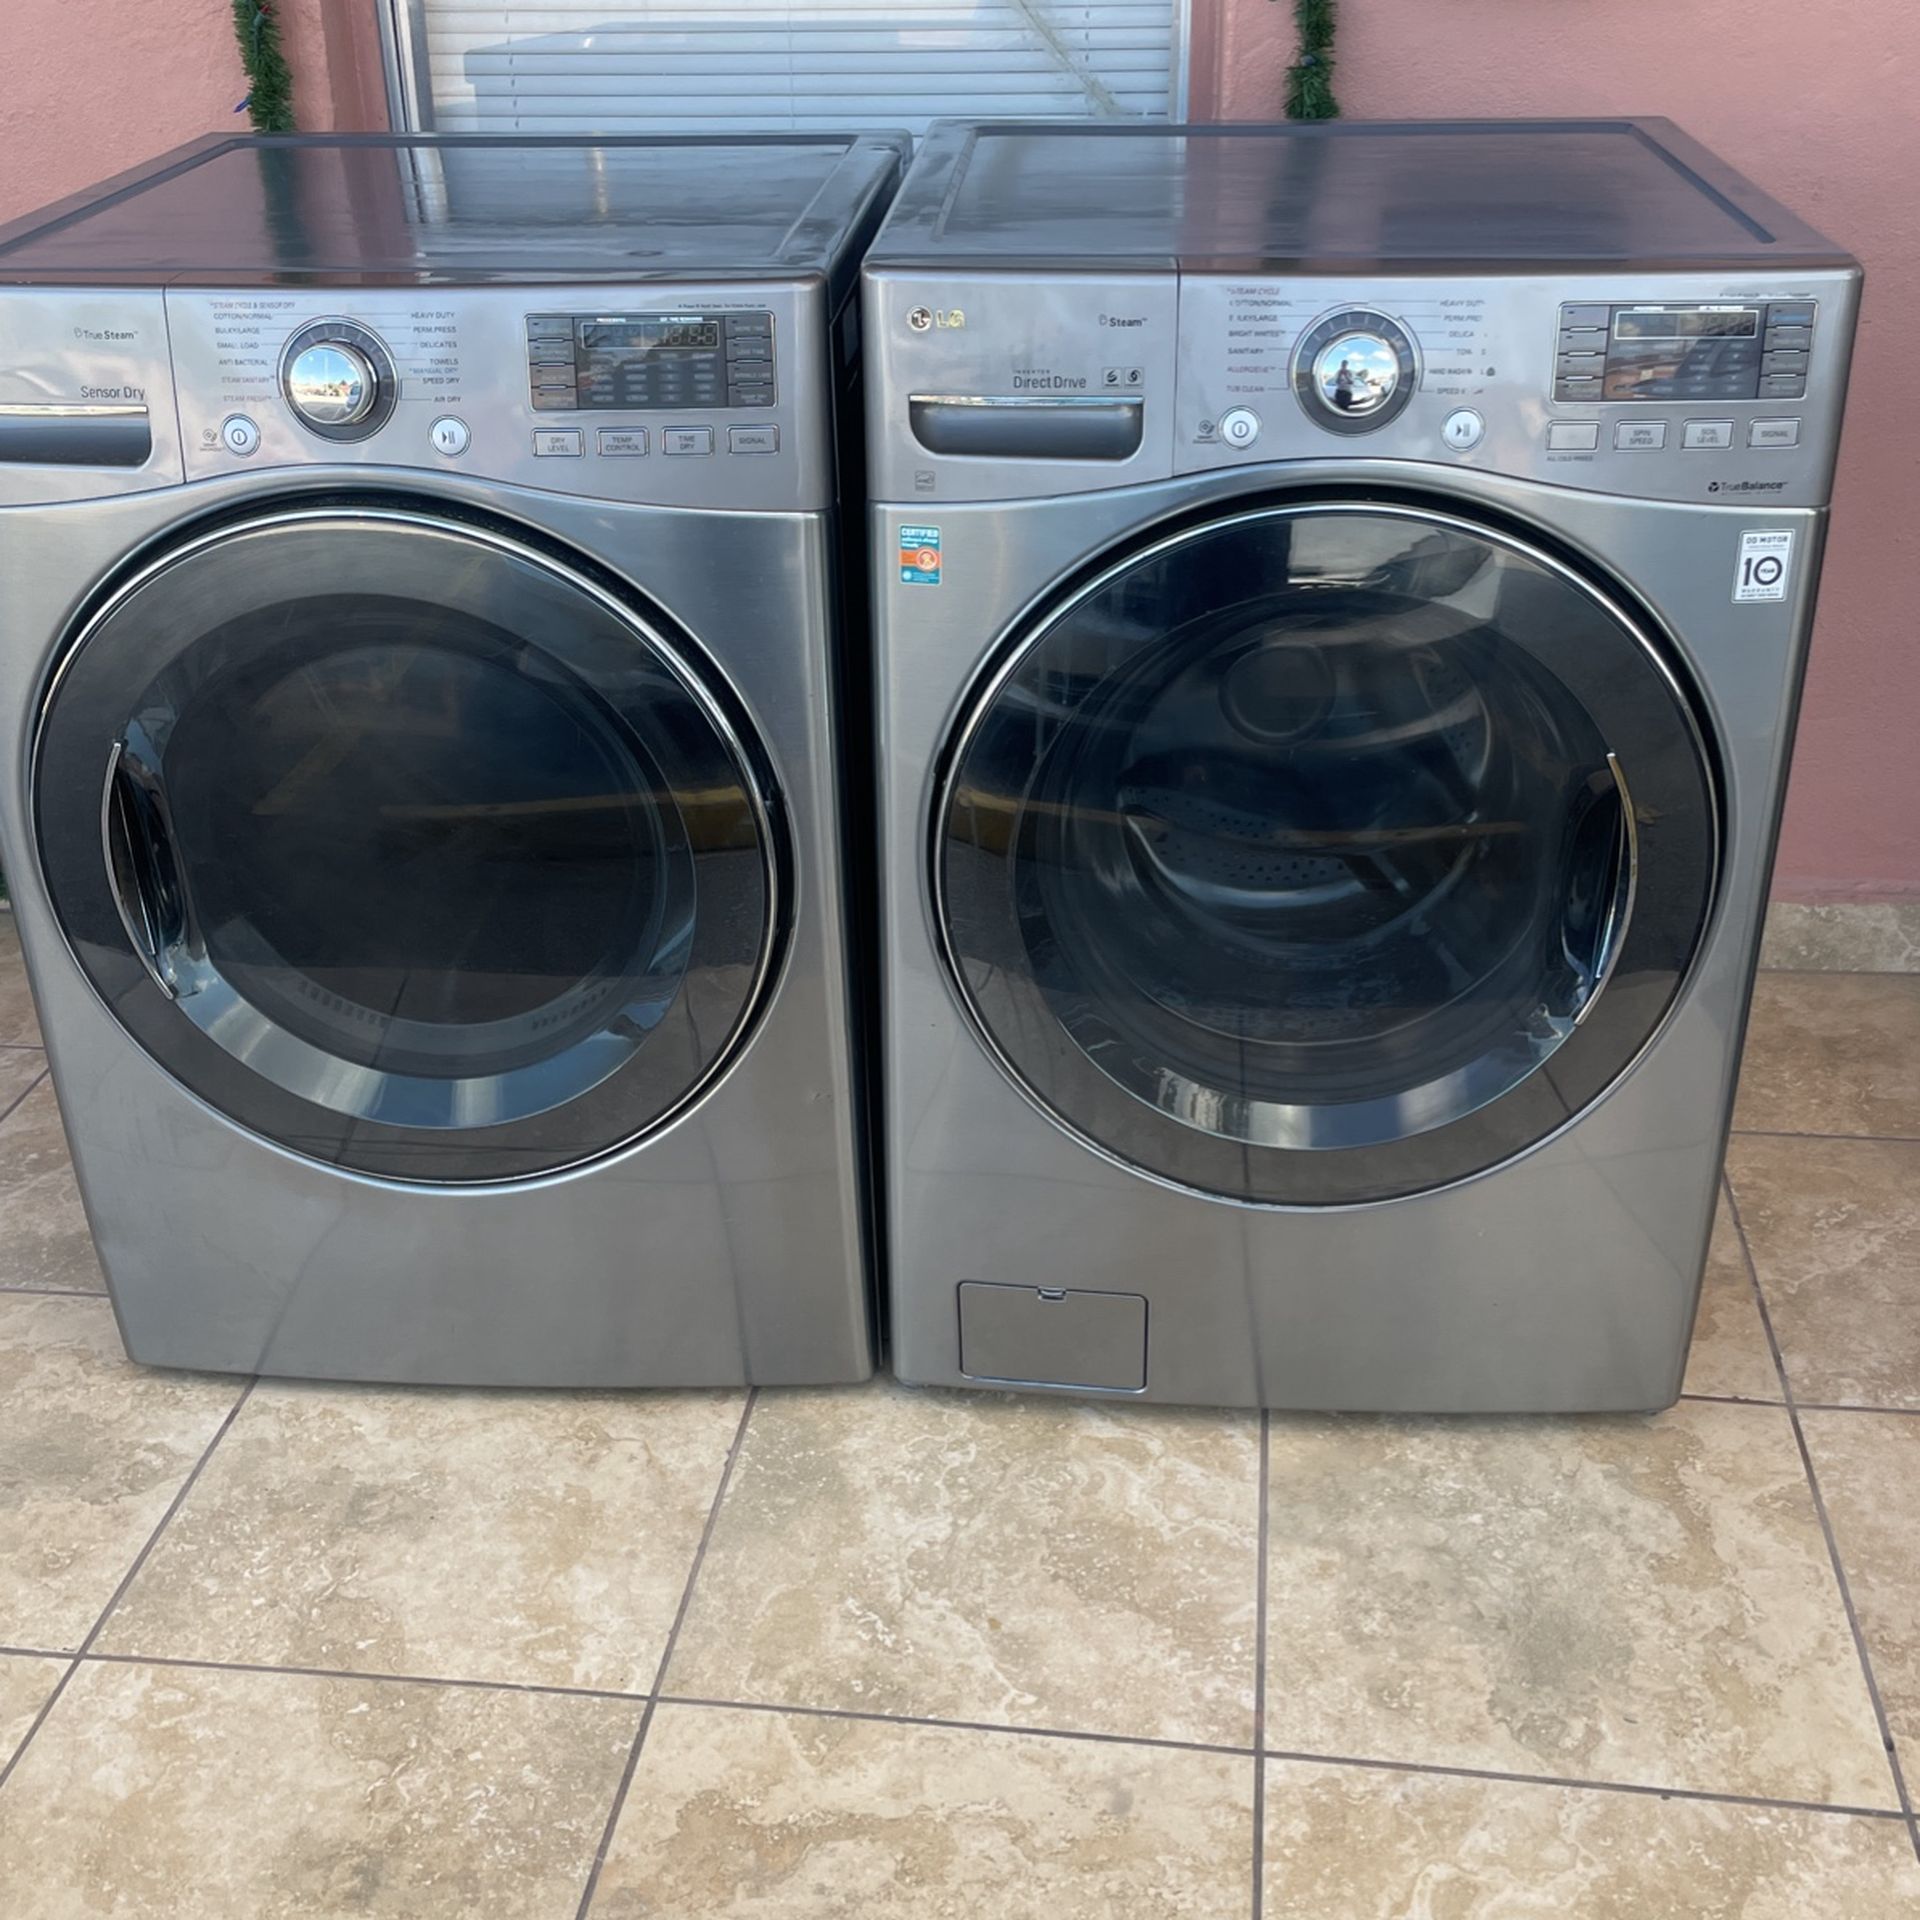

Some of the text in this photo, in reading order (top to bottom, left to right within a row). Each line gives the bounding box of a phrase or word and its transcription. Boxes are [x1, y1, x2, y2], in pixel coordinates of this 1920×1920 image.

[936, 309, 965, 329] LG
[1227, 347, 1265, 355] SANITARY
[430, 358, 459, 366] TOWELS
[1013, 376, 1087, 389] Direct Drive
[80, 385, 145, 401] Sensor Dry
[1633, 429, 1651, 437] SPIN
[1761, 430, 1789, 438] SIGNAL
[550, 436, 566, 444] DRY
[677, 435, 695, 443] TIME
[738, 436, 767, 445] SIGNAL
[547, 444, 569, 452] LEVEL
[605, 444, 641, 452] CONTROL
[679, 443, 695, 451] DRY
[1760, 535, 1788, 543] MOTOR
[1743, 556, 1783, 586] 10
